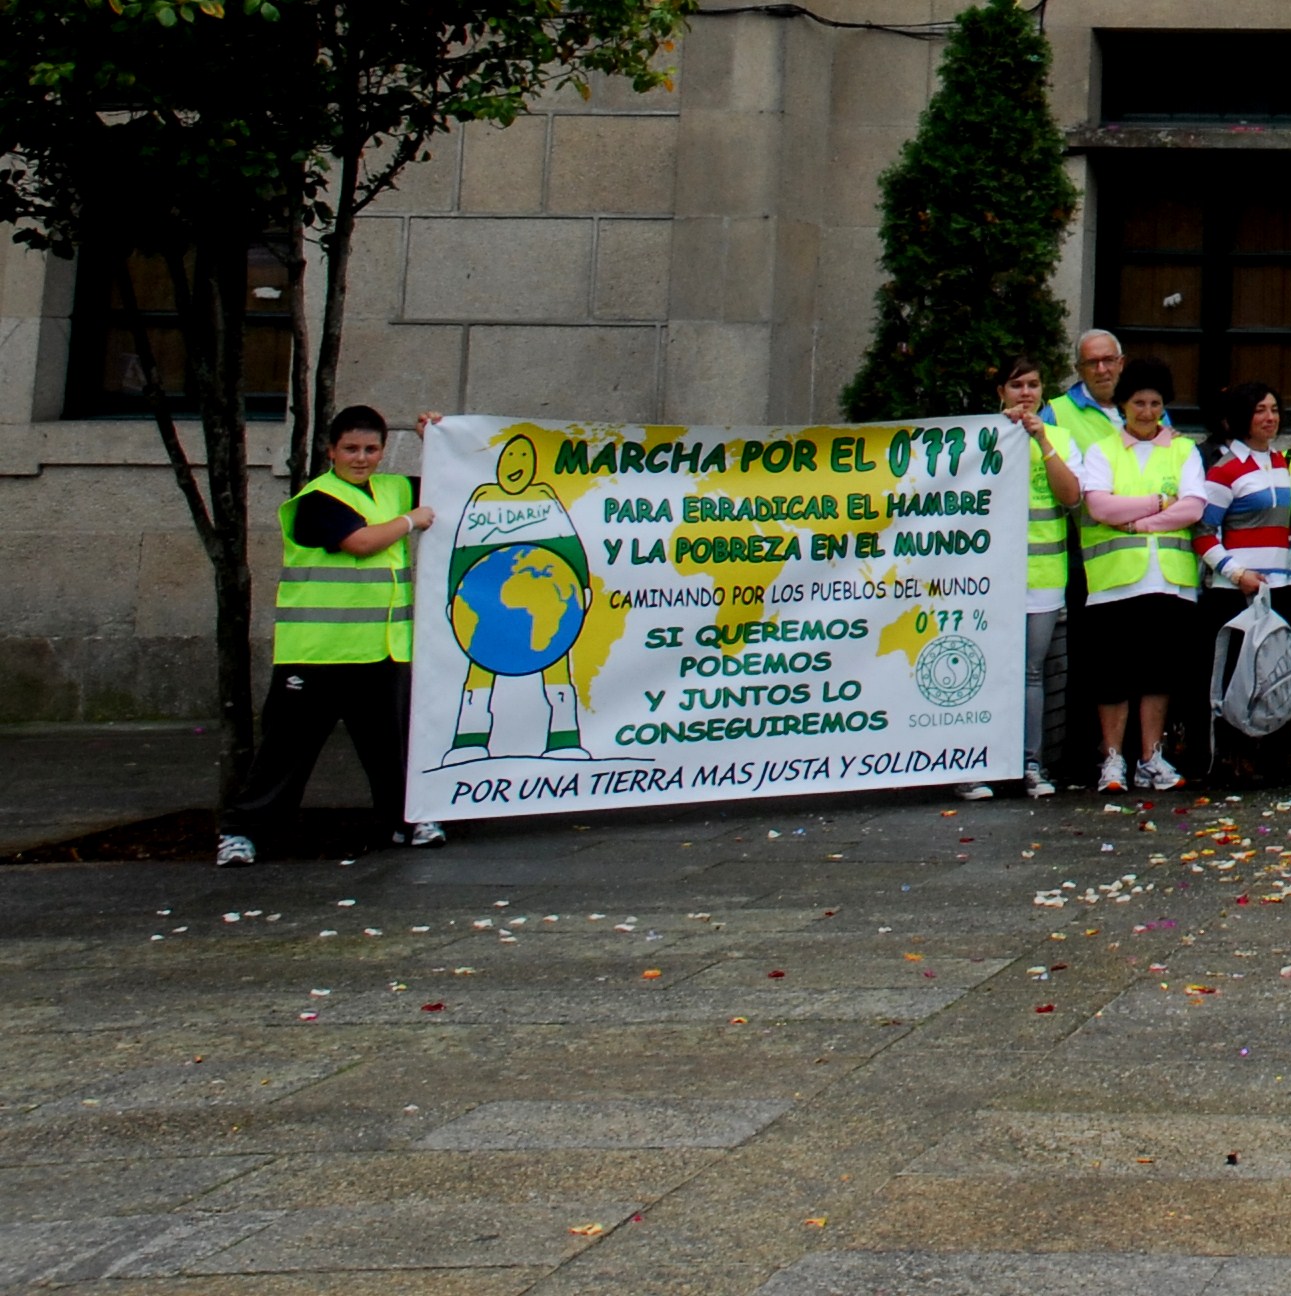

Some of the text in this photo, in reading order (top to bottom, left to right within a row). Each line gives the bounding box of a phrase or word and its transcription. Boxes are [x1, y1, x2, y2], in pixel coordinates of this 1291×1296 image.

[554, 439, 726, 475] MARCHA
[741, 440, 818, 473] POR
[830, 437, 876, 473] EL
[978, 426, 1003, 475] %
[604, 489, 992, 523] PARA ERRADICAR EL HAMBRE
[603, 529, 991, 565] Y LA POBREZA EN EL MUNDO
[609, 576, 991, 609] CAMINANDO POR LOS PUEBLOS DEL MUNDO
[645, 618, 869, 649] SI QUEREMOS
[972, 609, 988, 631] %
[680, 651, 832, 678] PODEMOS
[644, 680, 862, 712] Y JUNTOS LO
[615, 710, 889, 746] CONSEGUIREMOS
[451, 745, 990, 805] POR UNA TIERRA MAS JUSTA Y SOLIDARIA
